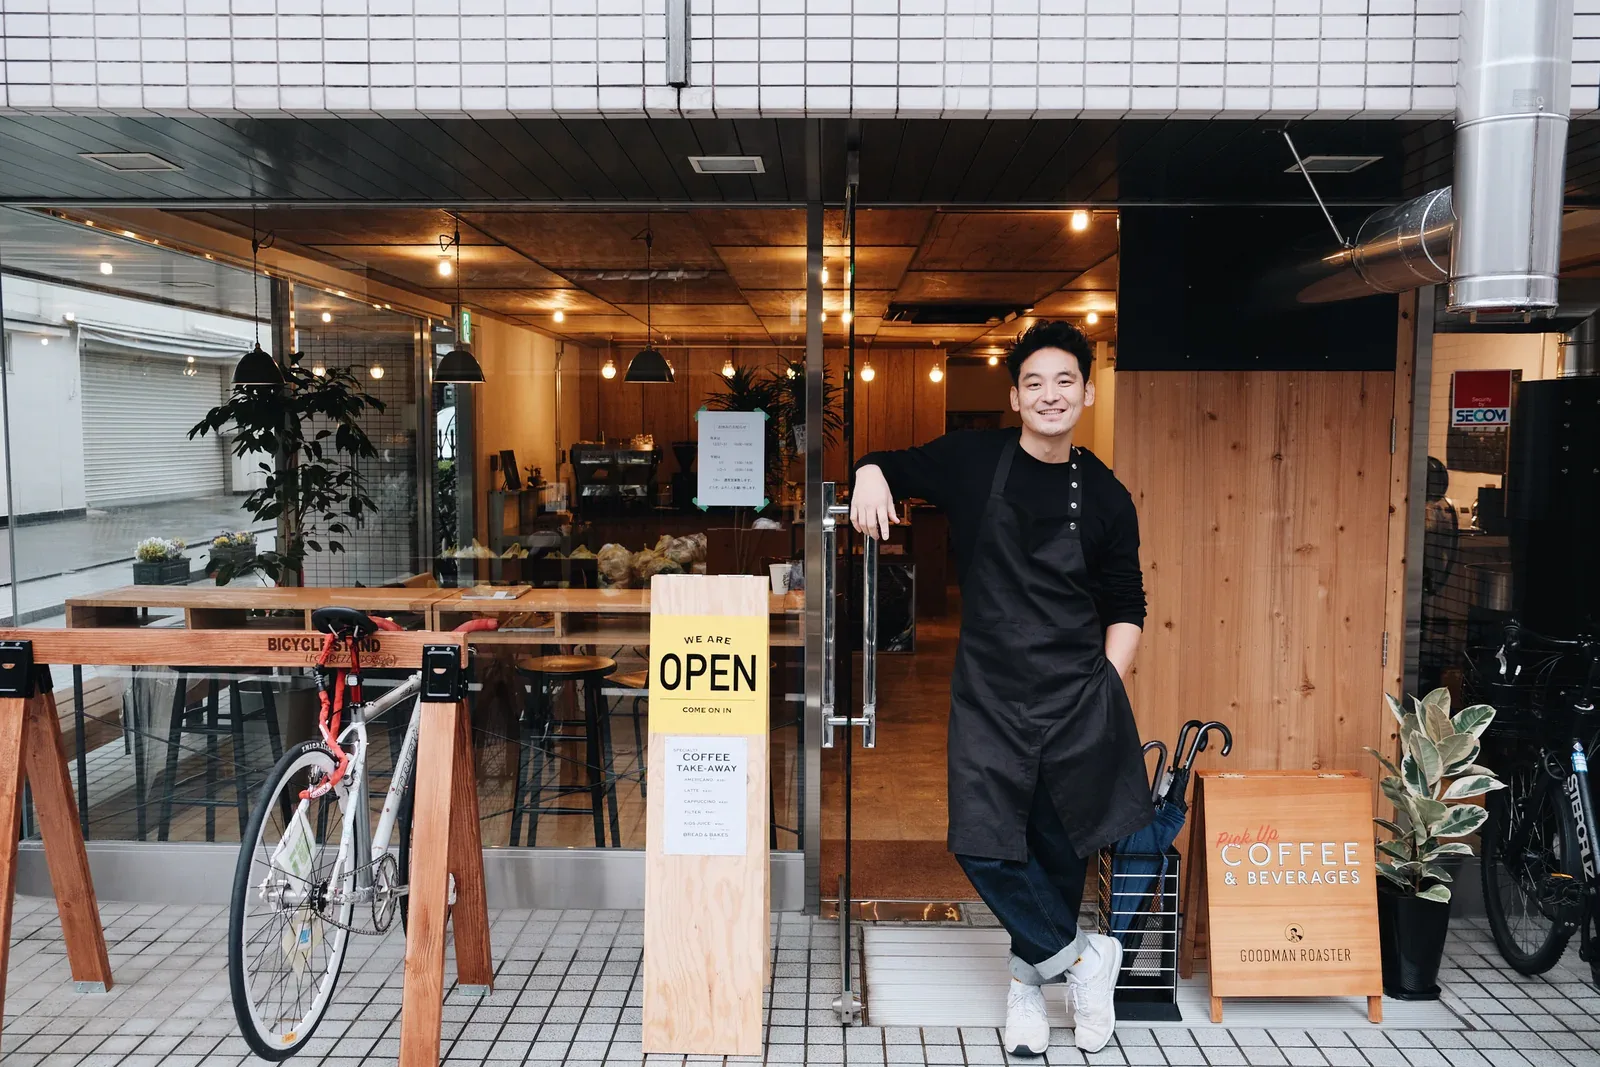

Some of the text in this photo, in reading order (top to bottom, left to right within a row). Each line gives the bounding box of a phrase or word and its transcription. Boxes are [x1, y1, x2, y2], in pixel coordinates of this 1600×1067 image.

[1456, 409, 1506, 422] SECOM
[684, 635, 732, 645] WE ARE
[659, 652, 757, 692] OPEN
[682, 706, 706, 714] COME
[682, 752, 731, 762] COFFEE
[676, 764, 738, 773] TAKE-AWAY
[1216, 825, 1279, 847] Pick Up
[1221, 842, 1361, 867] COFFEE
[1224, 869, 1361, 886] & BEVERAGES
[1240, 948, 1351, 963] GOODMAN ROASTER
